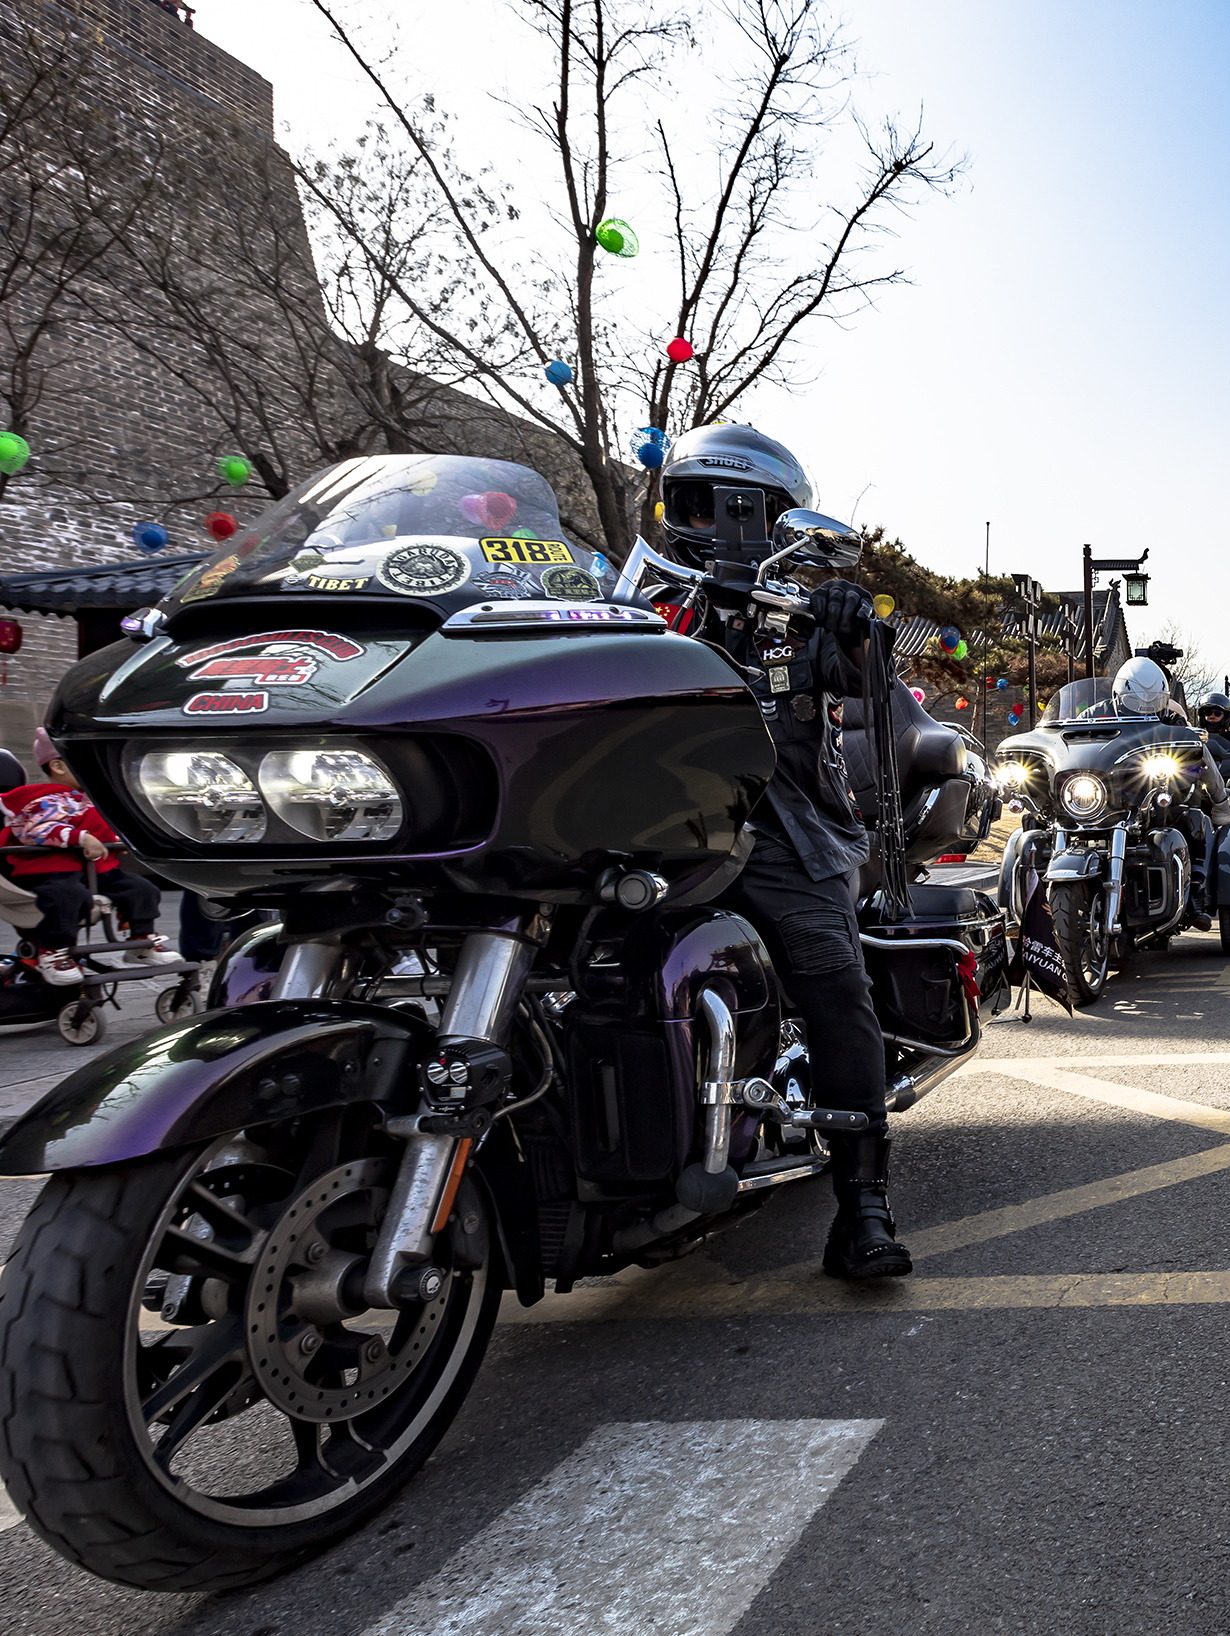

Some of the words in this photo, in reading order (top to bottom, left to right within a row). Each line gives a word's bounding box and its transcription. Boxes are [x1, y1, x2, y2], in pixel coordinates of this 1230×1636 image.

[486, 540, 551, 562] 318
[308, 575, 369, 591] TIBET
[188, 693, 264, 712] CHINA
[1022, 950, 1062, 977] AIYUAN
